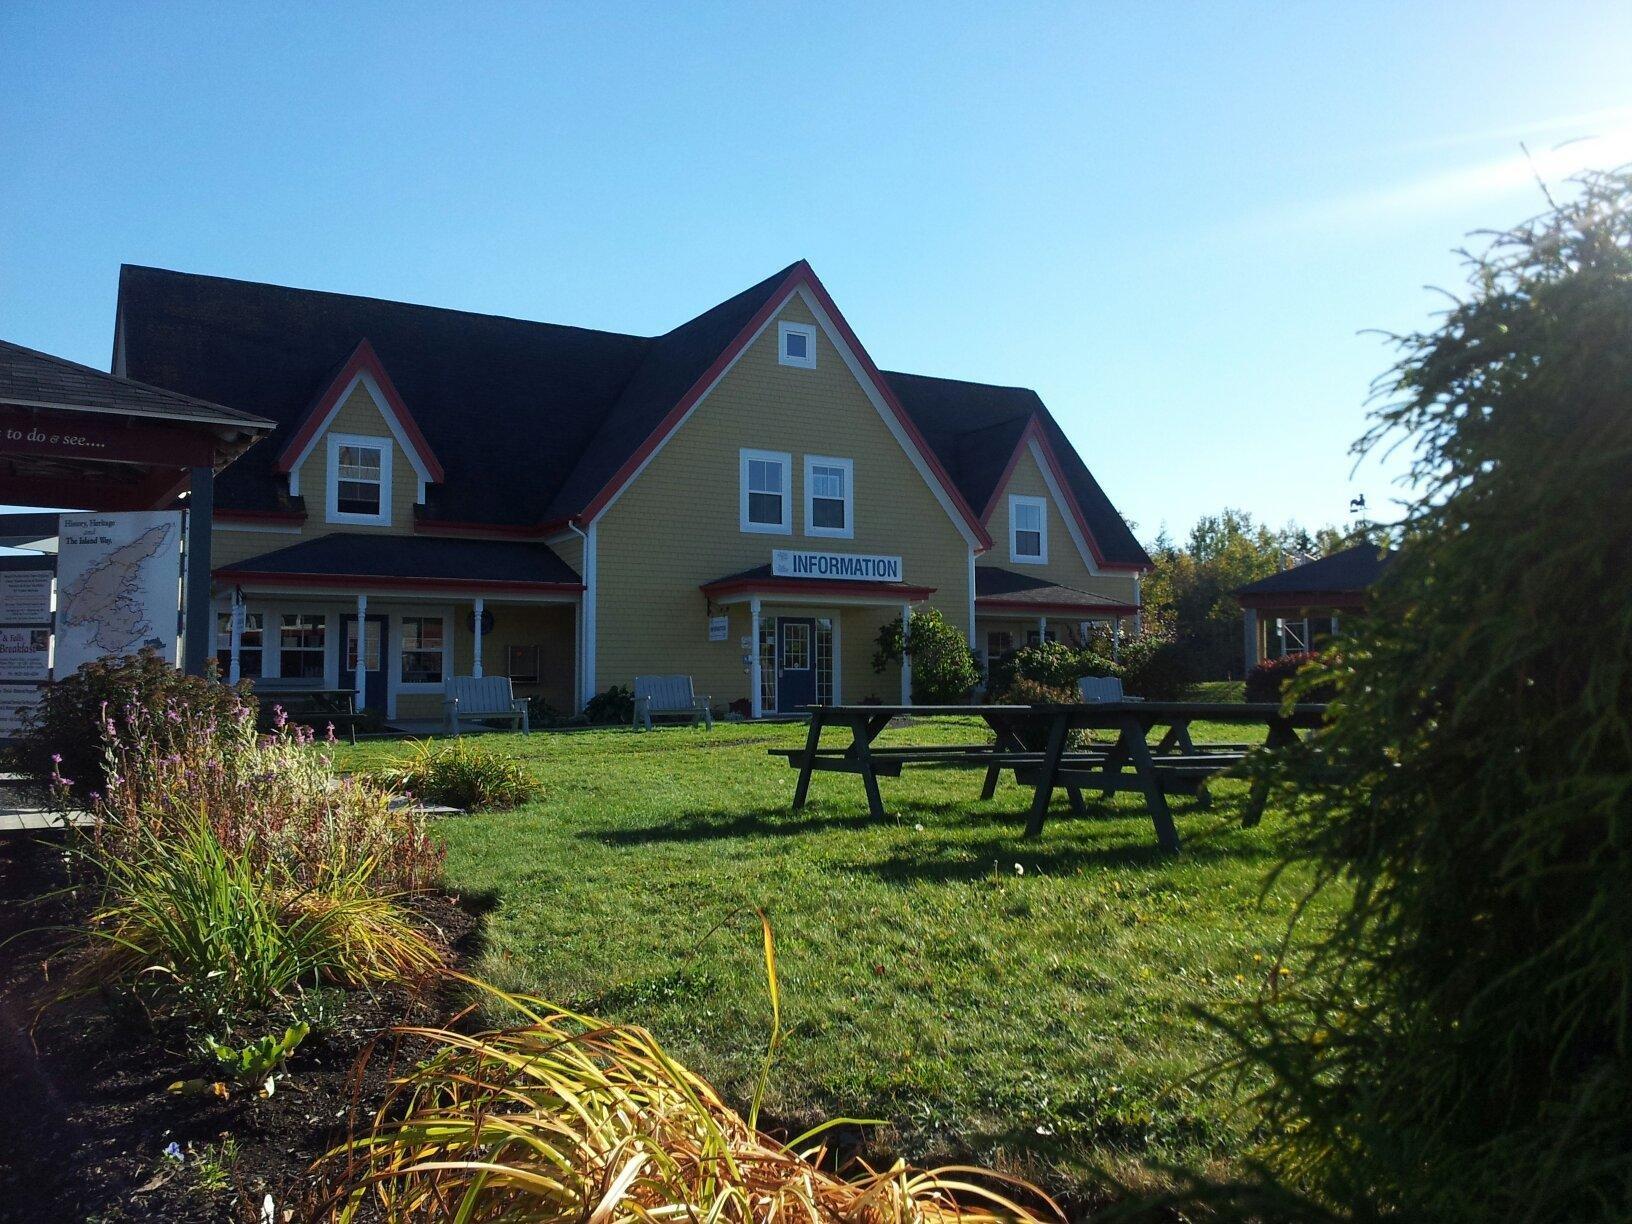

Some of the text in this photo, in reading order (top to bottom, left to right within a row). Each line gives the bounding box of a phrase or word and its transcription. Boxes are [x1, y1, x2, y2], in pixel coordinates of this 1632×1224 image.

[7, 429, 22, 440] to
[27, 428, 46, 442] do
[65, 537, 78, 545] The
[793, 555, 898, 578] INFORMATION
